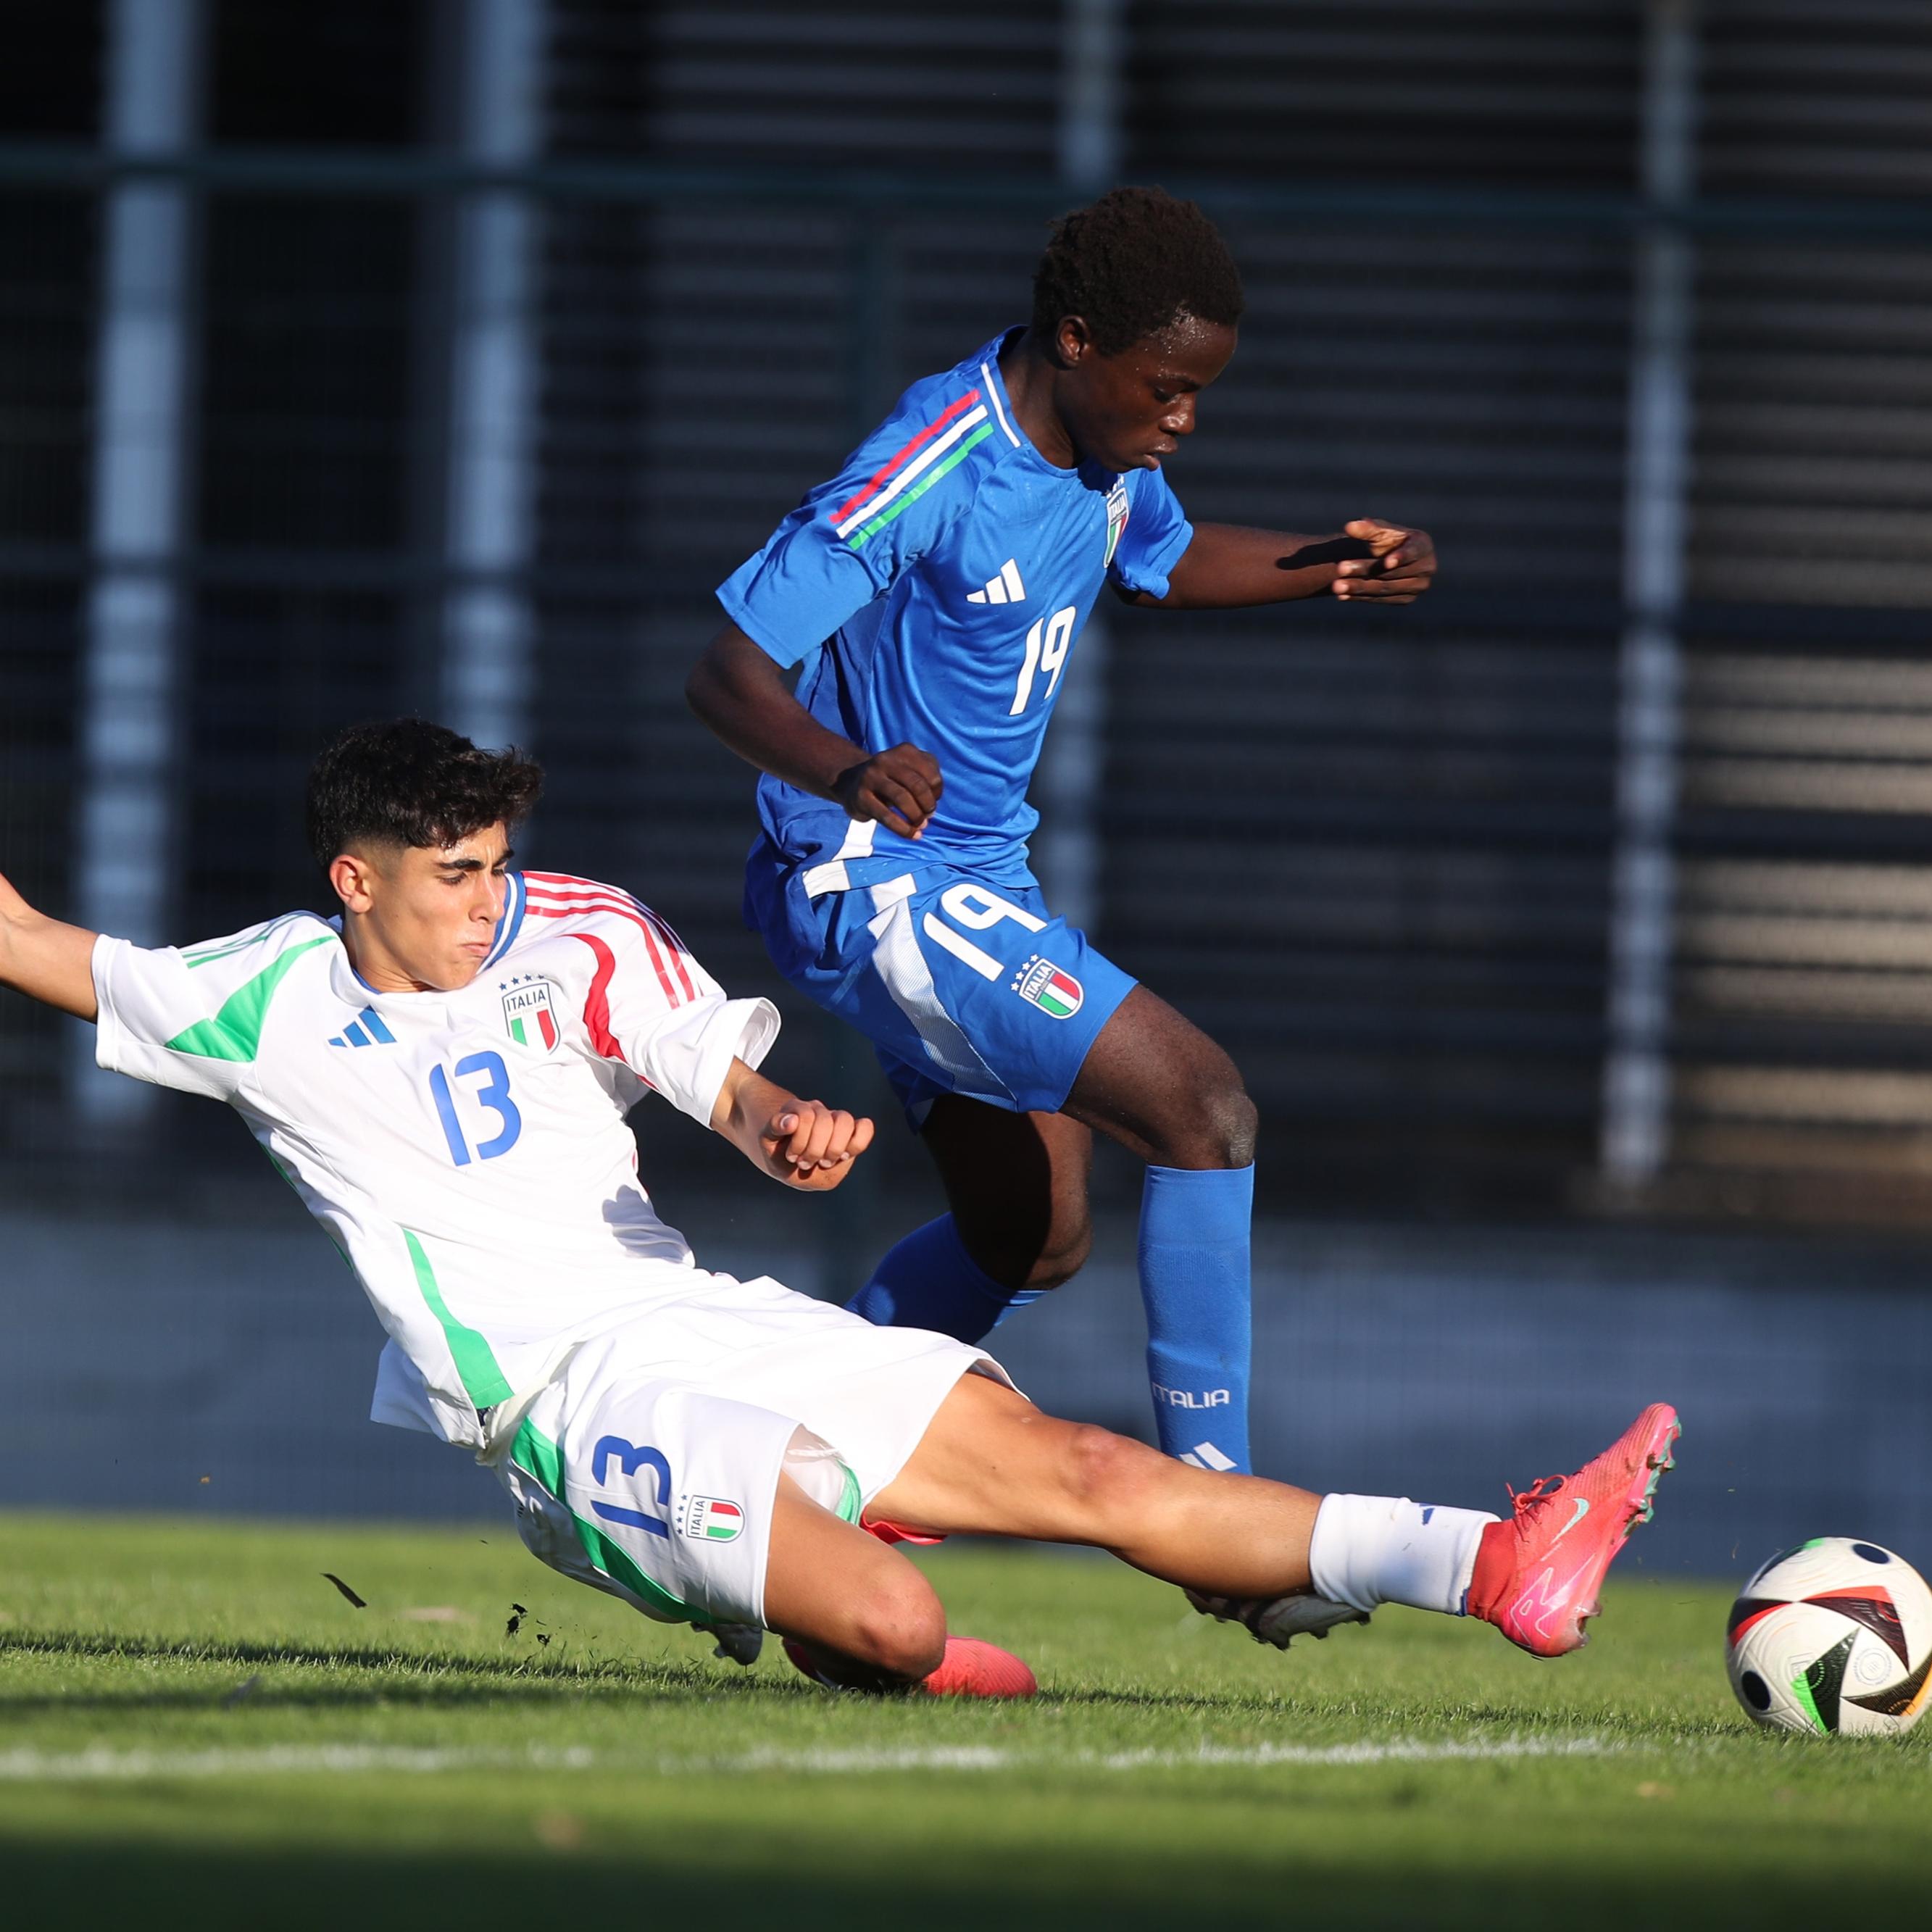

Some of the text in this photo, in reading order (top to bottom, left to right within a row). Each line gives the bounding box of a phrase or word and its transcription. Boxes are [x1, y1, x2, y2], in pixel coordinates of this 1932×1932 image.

[1009, 606, 1076, 715] 19
[923, 883, 1048, 982] 19
[507, 989, 546, 1012] ITALIA
[1023, 965, 1052, 999] ITALIA
[429, 1051, 522, 1167] 13
[1152, 1382, 1230, 1409] ITALIA
[590, 1435, 672, 1540] 13
[691, 1500, 705, 1535] ITALIA
